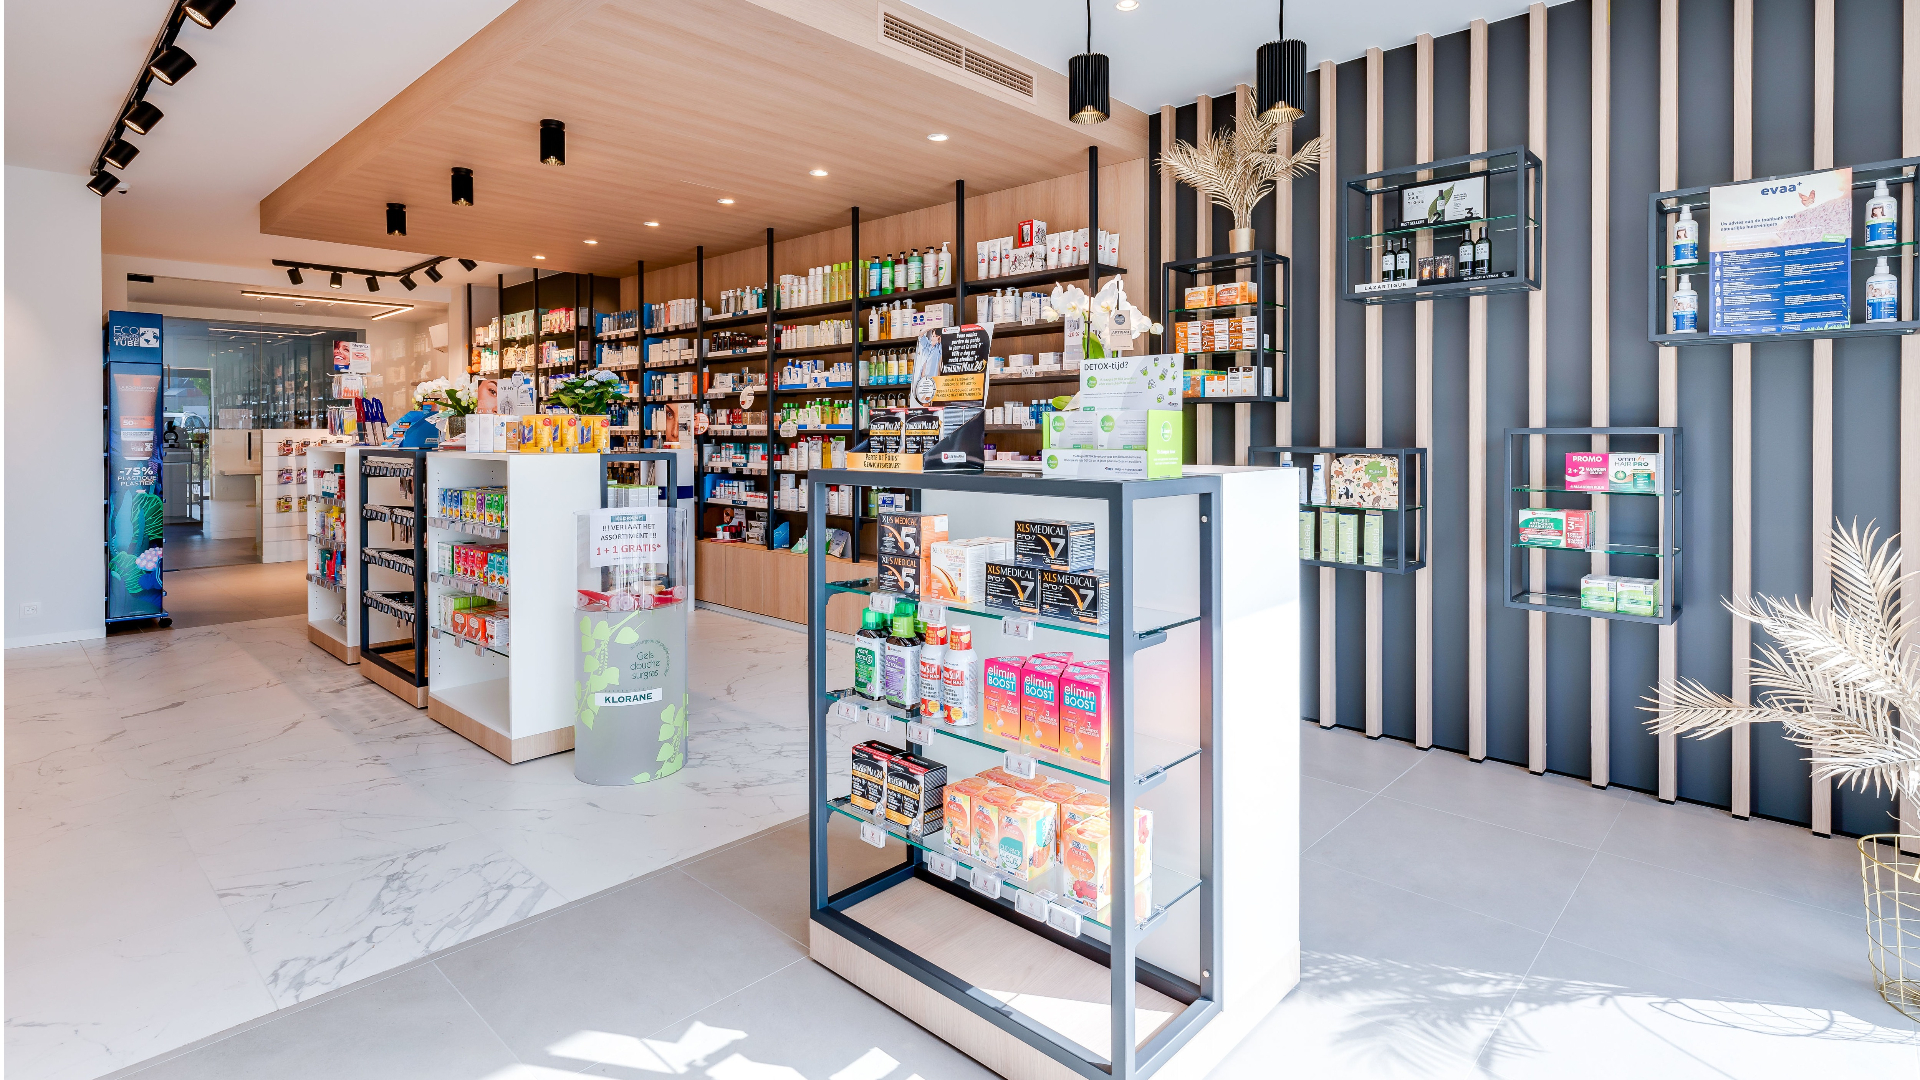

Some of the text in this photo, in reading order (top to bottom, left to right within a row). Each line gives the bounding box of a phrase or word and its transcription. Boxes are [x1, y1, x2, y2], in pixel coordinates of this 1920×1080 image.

[1084, 362, 1129, 371] DETOX-tijd?
[1572, 455, 1603, 463] PROMO
[119, 466, 155, 476] -75%
[1579, 466, 1586, 475] 2
[1016, 523, 1066, 537] XLS MEDICAL
[1567, 521, 1575, 531] 3
[901, 526, 916, 555] 5
[1051, 538, 1066, 558] 7
[596, 547, 601, 556] 1
[612, 545, 618, 554] 1
[987, 564, 1035, 580] XLS MEDICAL
[901, 568, 915, 594] 5
[1042, 572, 1095, 588] XLS MEDICAL
[1020, 581, 1035, 601] 7
[1079, 589, 1095, 611] 7
[987, 665, 1016, 679] elimin
[988, 676, 1016, 690] BOOST
[1024, 674, 1053, 690] elimin
[604, 693, 653, 703] KLORANE
[1025, 685, 1053, 700] BOOST
[1064, 683, 1095, 700] elimin
[1064, 695, 1095, 711] BOOST
